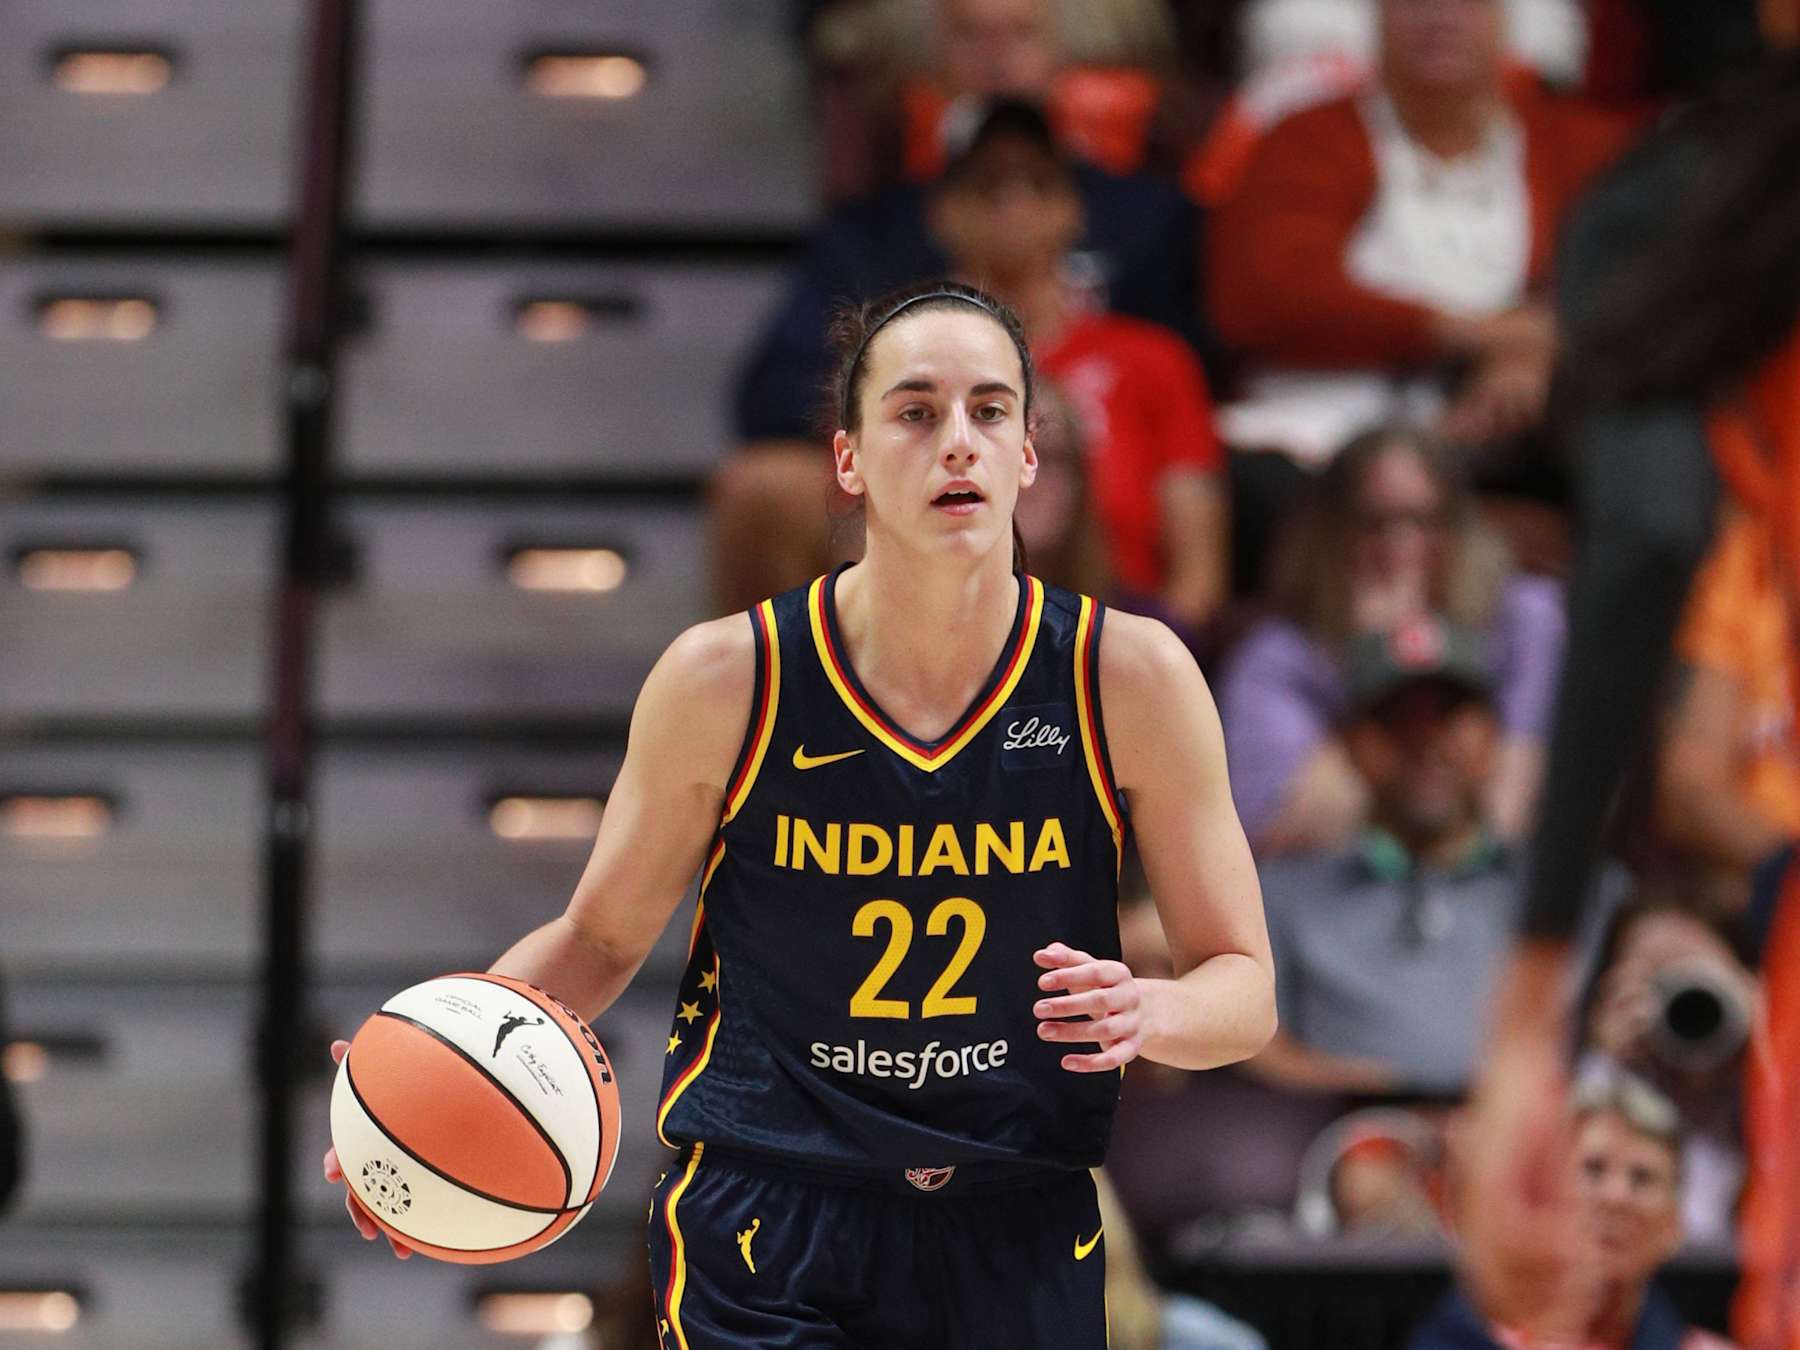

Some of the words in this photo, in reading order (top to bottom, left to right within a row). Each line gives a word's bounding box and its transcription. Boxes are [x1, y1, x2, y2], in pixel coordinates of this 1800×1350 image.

[1003, 716, 1071, 755] Lilly
[774, 814, 1072, 877] INDIANA
[850, 897, 987, 1020] 22
[810, 1039, 1009, 1090] salesforce
